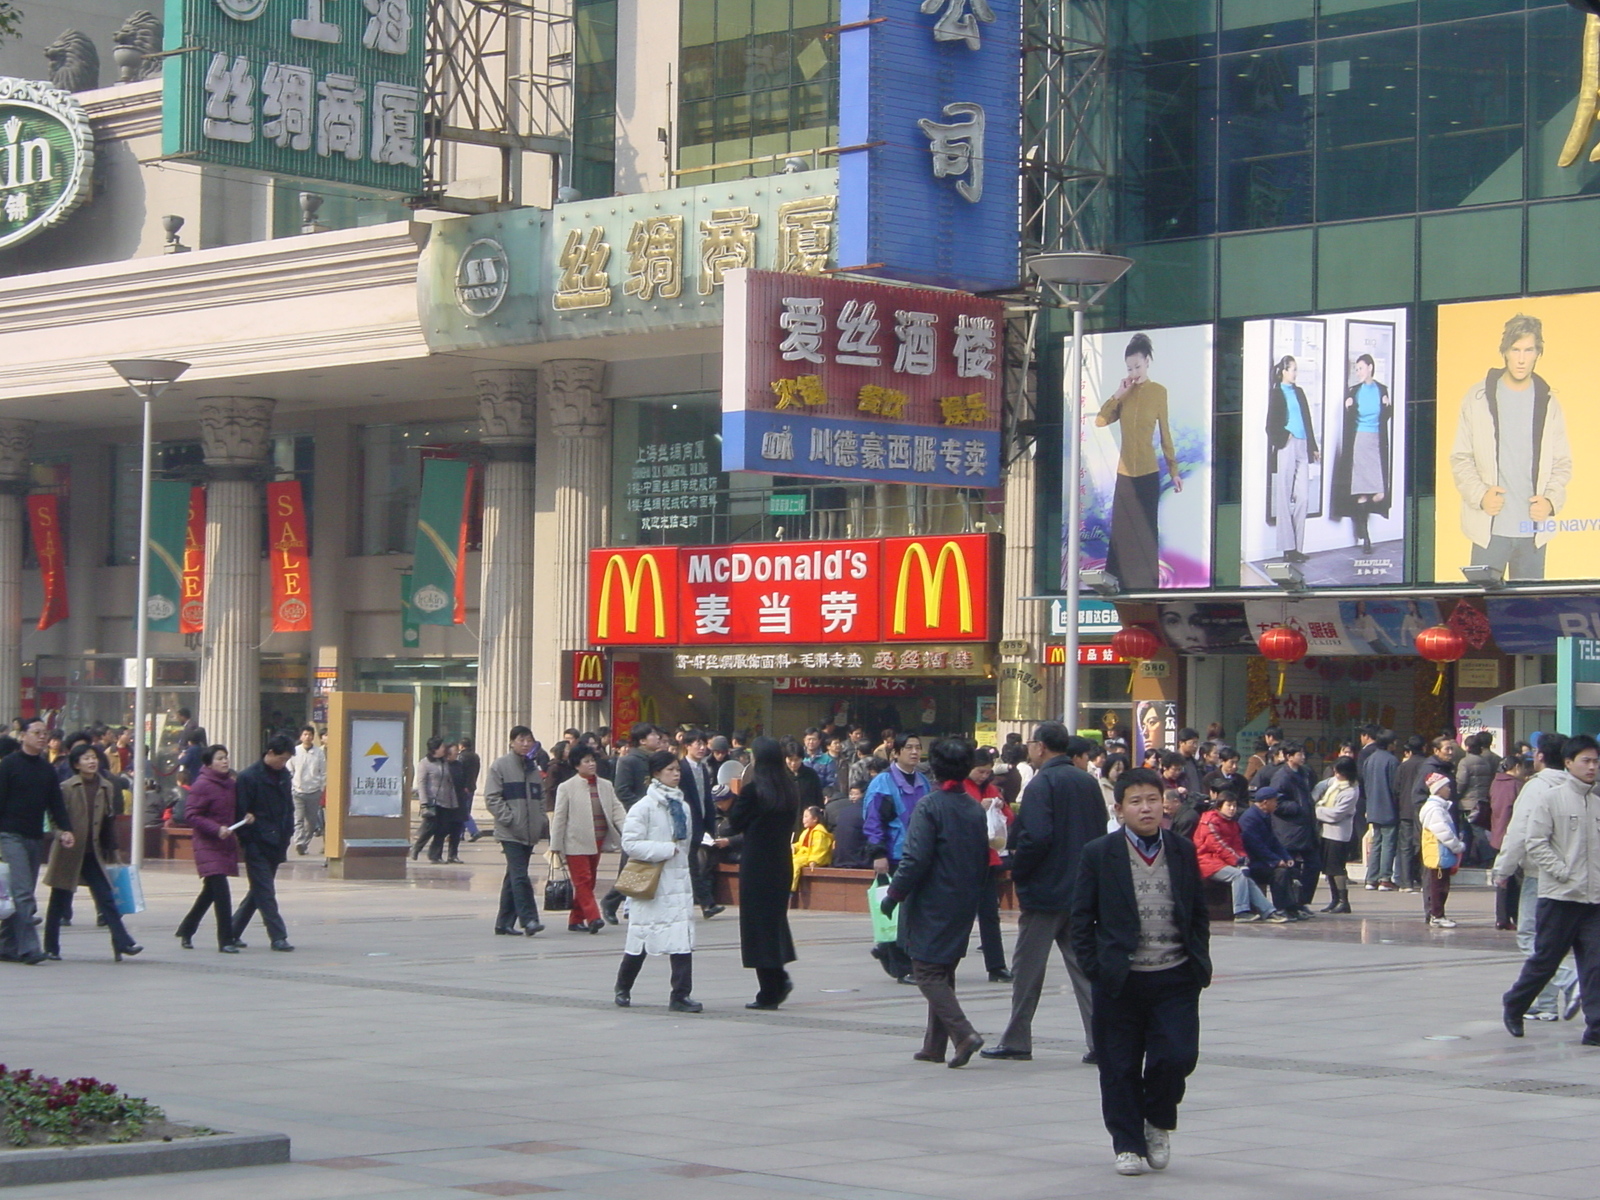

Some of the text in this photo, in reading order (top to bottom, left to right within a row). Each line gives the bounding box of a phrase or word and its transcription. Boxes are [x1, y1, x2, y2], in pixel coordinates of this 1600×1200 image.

[204, 51, 420, 168] 丝绸商厦
[0, 138, 53, 190] in
[552, 194, 839, 311] 丝绸商厦
[779, 296, 997, 380] 爱丝酒楼
[687, 549, 868, 584] McDonald's
[694, 590, 859, 635] 麦当劳
[1579, 639, 1600, 660] TEL
[354, 777, 398, 789] 上海银行
